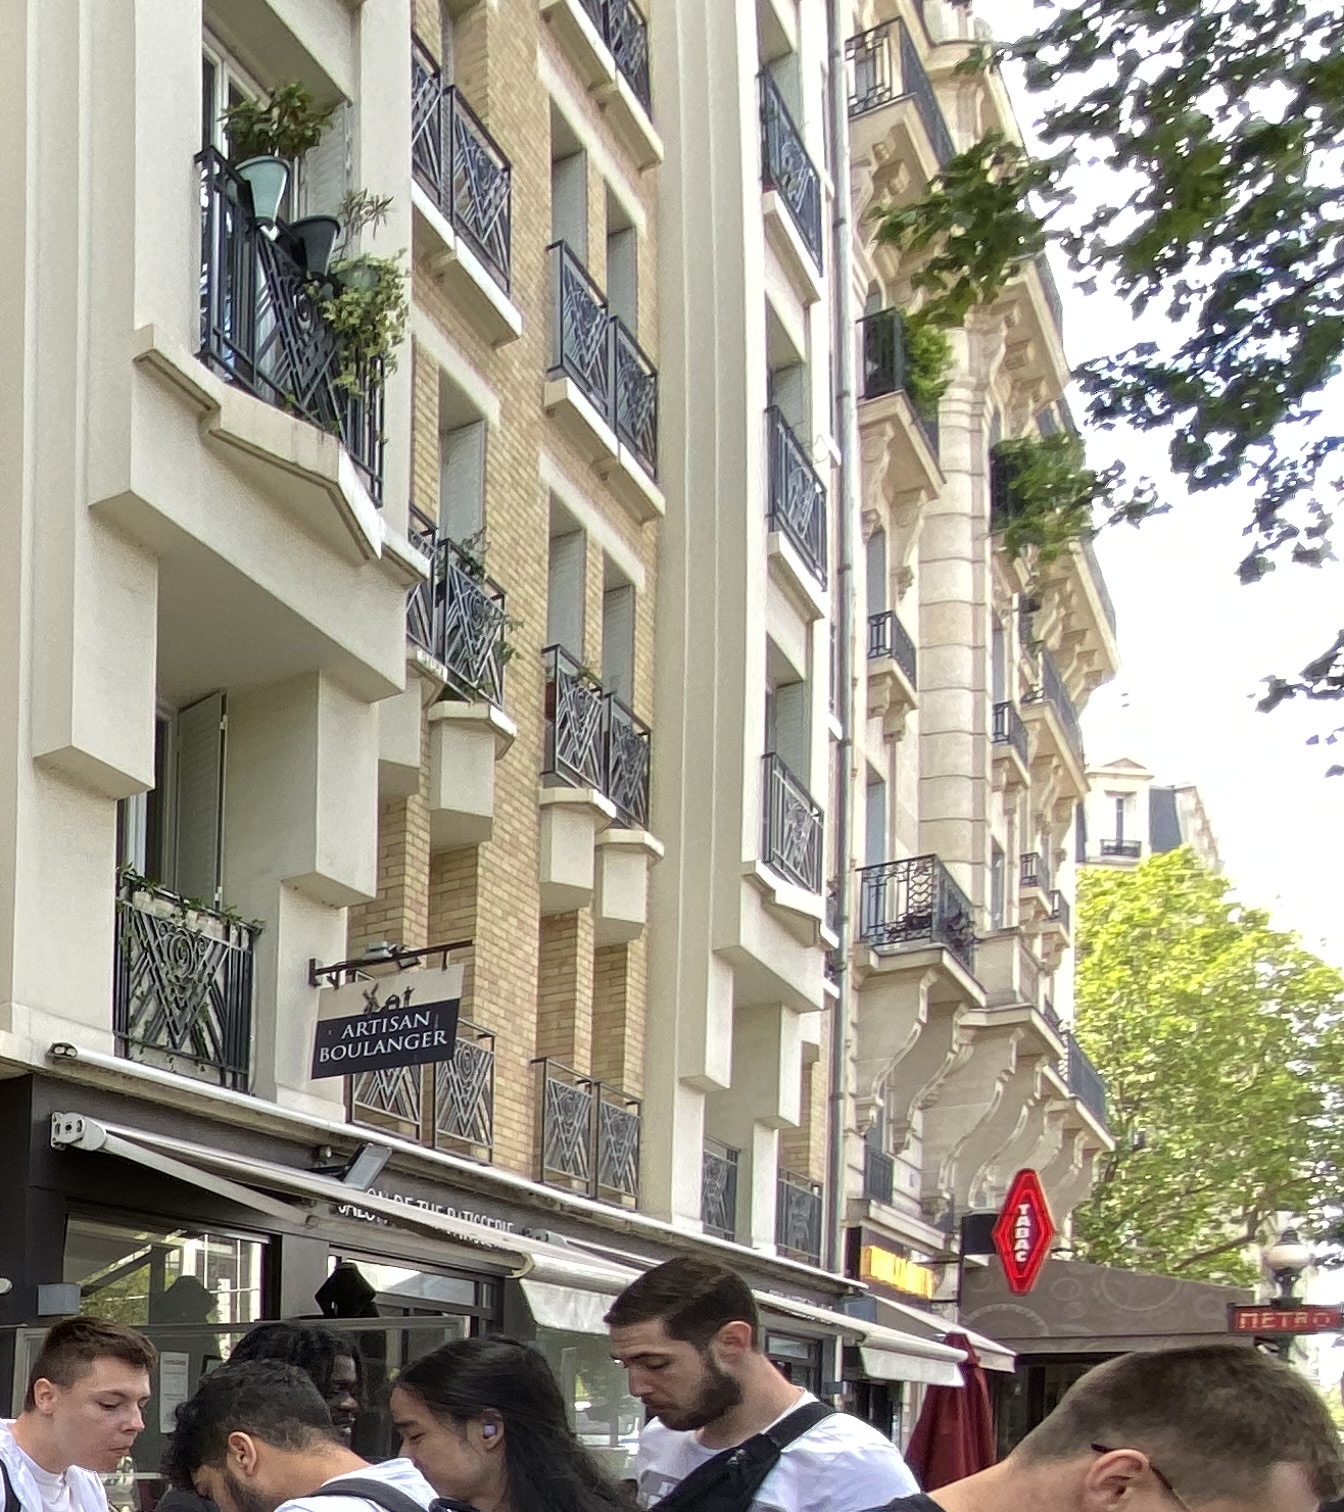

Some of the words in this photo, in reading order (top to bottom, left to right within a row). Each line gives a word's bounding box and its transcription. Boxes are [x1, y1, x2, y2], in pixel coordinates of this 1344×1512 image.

[341, 1011, 432, 1040] ARTISAN
[319, 1030, 448, 1063] BOULANGER
[1014, 1203, 1031, 1262] TABAC
